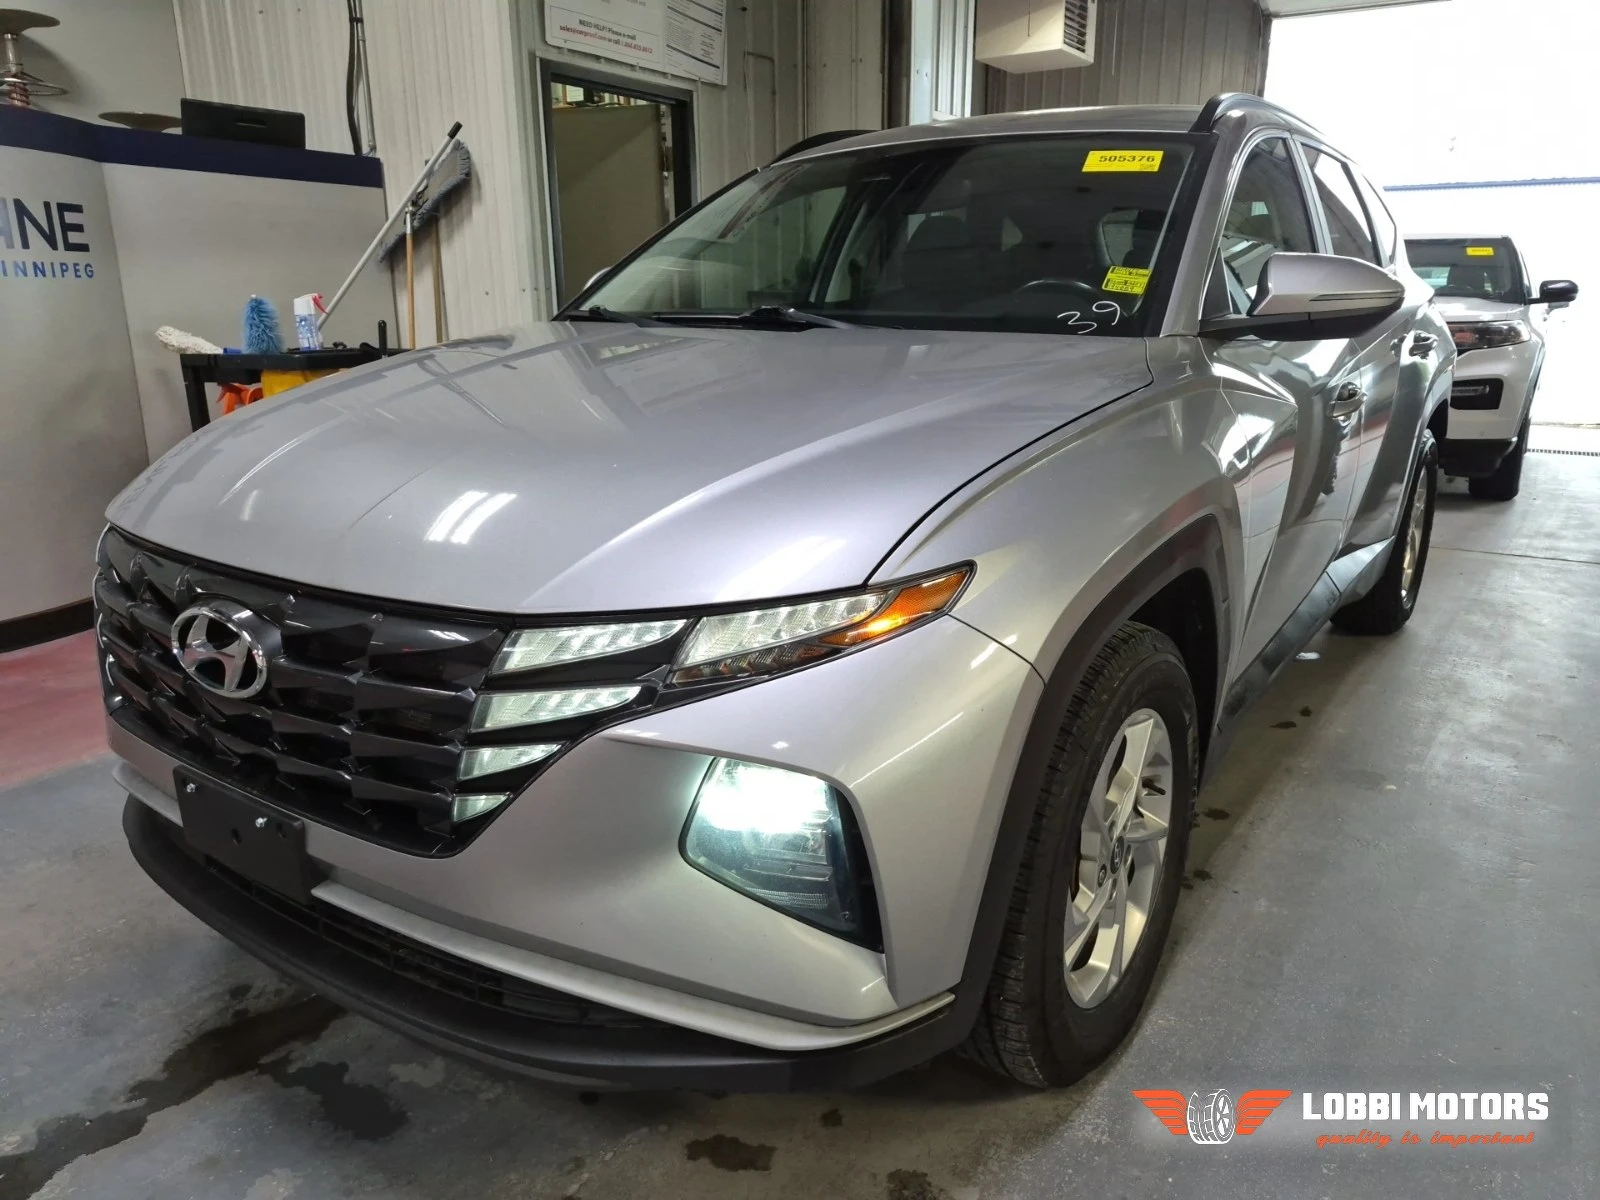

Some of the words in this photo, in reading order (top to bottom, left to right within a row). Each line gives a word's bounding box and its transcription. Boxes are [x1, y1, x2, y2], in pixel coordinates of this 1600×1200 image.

[578, 19, 593, 29] NEED
[593, 23, 608, 33] HELP!
[608, 27, 622, 37] Please
[1098, 155, 1155, 163] 505376
[1, 259, 95, 279] INNIPEG
[1056, 300, 1120, 335] 39
